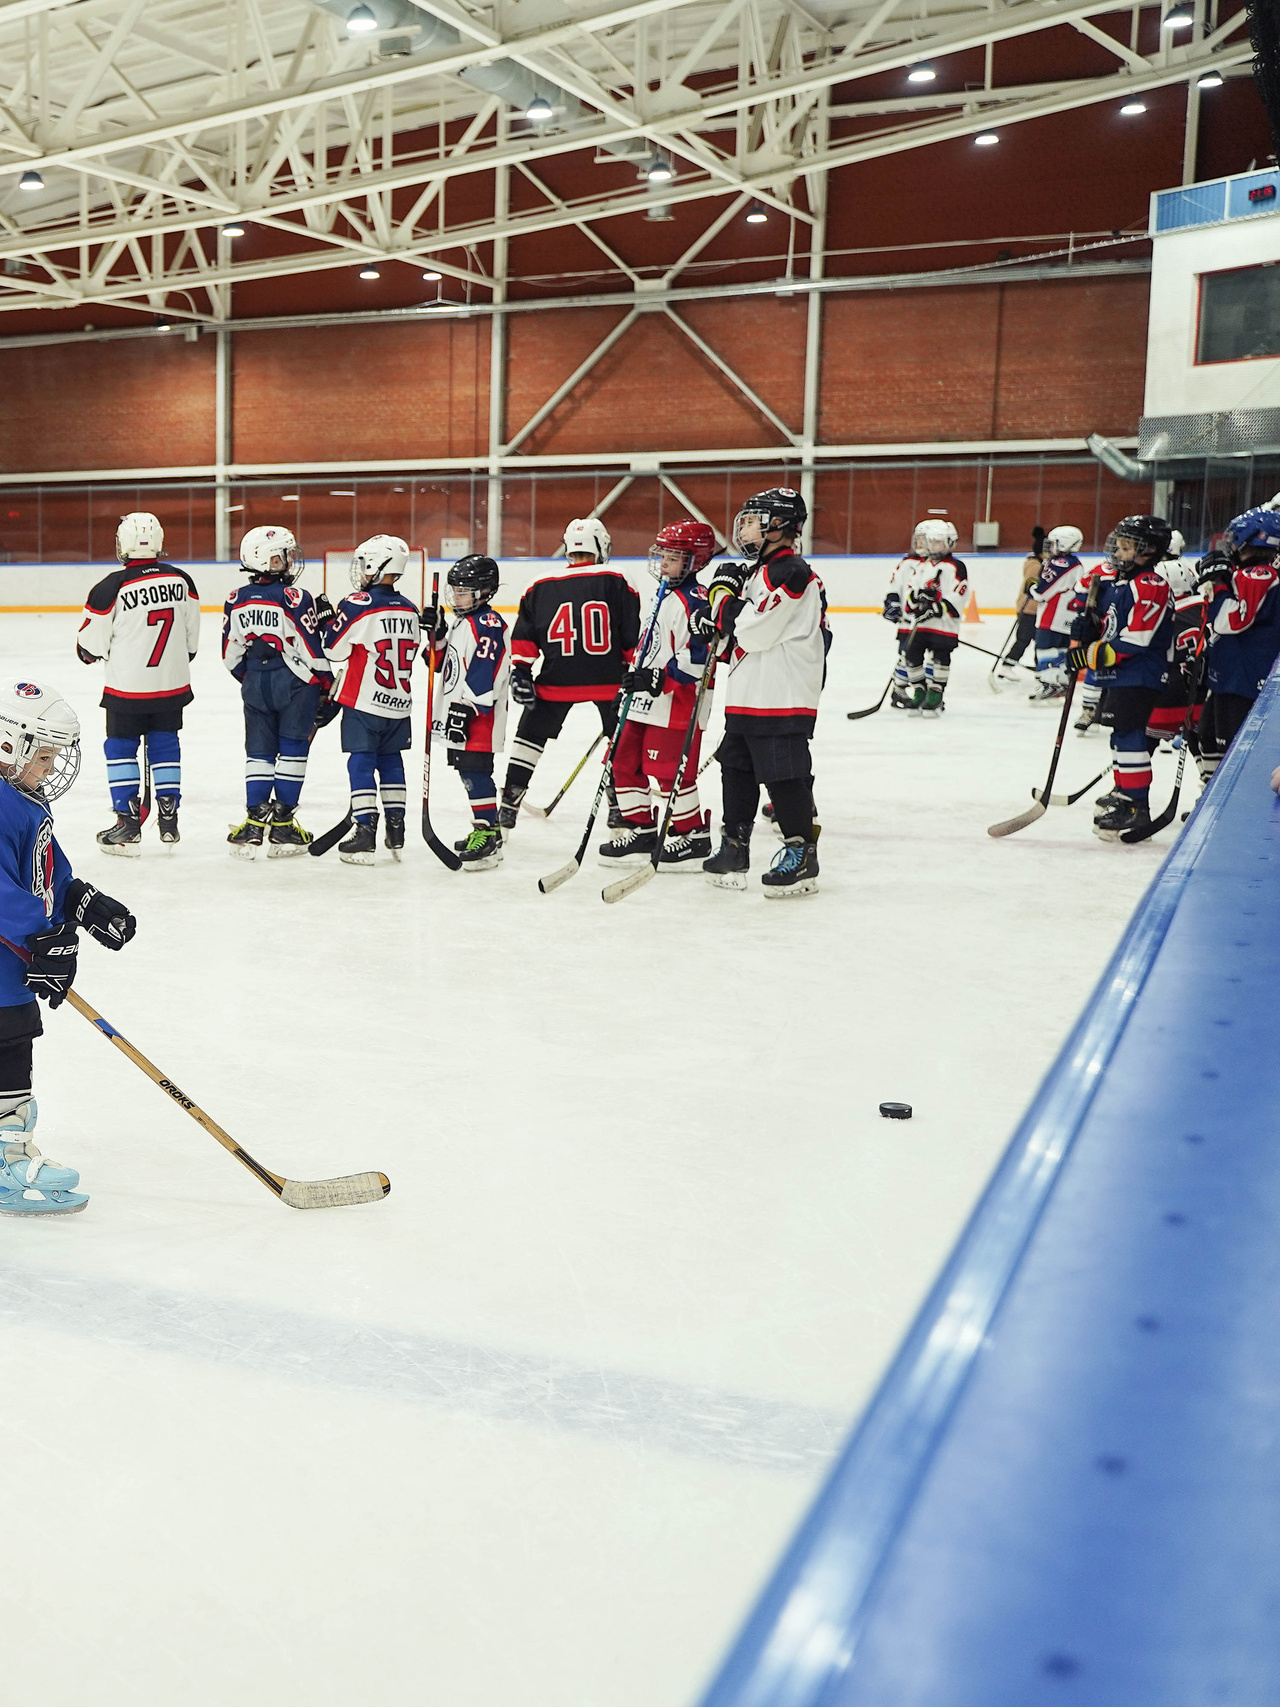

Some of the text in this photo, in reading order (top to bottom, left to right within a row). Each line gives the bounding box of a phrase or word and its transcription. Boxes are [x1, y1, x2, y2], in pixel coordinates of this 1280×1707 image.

[145, 607, 175, 668] 7
[547, 600, 612, 657] 40
[651, 667, 661, 689] CM
[75, 886, 99, 923] BAU
[157, 1078, 196, 1112] OROKS
